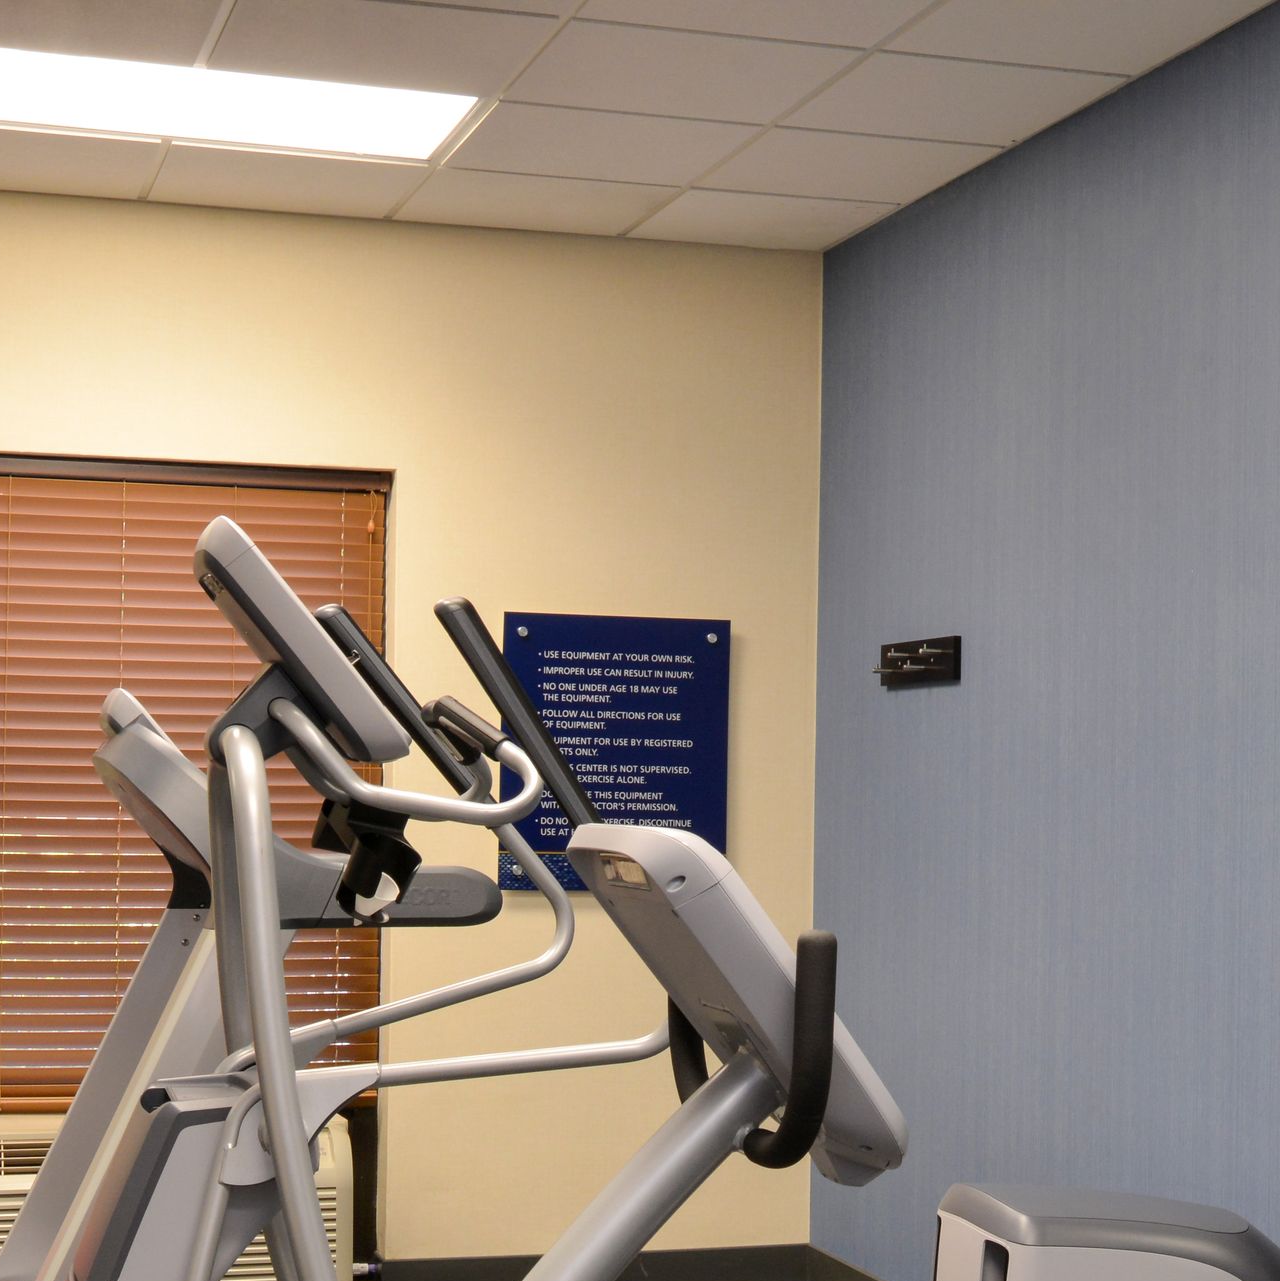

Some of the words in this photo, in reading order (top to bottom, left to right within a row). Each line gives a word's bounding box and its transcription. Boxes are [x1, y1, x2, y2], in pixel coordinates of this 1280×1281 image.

[544, 651, 559, 659] USE
[562, 652, 610, 660] EQUIPMENT
[626, 654, 649, 662] YOUR
[651, 654, 672, 663] OWN
[675, 655, 695, 663] RISK.
[544, 667, 585, 675] IMPROPER
[587, 668, 602, 676] USE
[604, 669, 621, 677] CAN
[624, 670, 652, 678] RESULT
[665, 671, 694, 679] INJURY.
[558, 683, 576, 691] ONE
[579, 684, 607, 692] UNDER
[561, 694, 612, 703] EQUIPMENT.
[543, 709, 578, 718] FOLLOW
[597, 711, 645, 720] DIRECTIONS
[666, 713, 681, 721] USE
[556, 721, 606, 730] EQUIPMENT.
[554, 737, 592, 745] UIPMENT
[613, 738, 628, 746] USE
[644, 739, 693, 748] REGISTERED
[575, 748, 598, 756] ONLY.
[576, 764, 608, 772] CENTER
[620, 765, 638, 773] NOT
[640, 766, 692, 774] SUPERVISED.
[577, 775, 614, 783] EXERCISE
[616, 776, 647, 784] ALONE.
[595, 791, 612, 799] THIS
[615, 792, 663, 800] EQUIPMENT
[627, 803, 678, 812] PERMISSION.
[541, 817, 553, 825] DO
[639, 819, 692, 828] DISCONTINUE
[541, 828, 556, 836] USE
